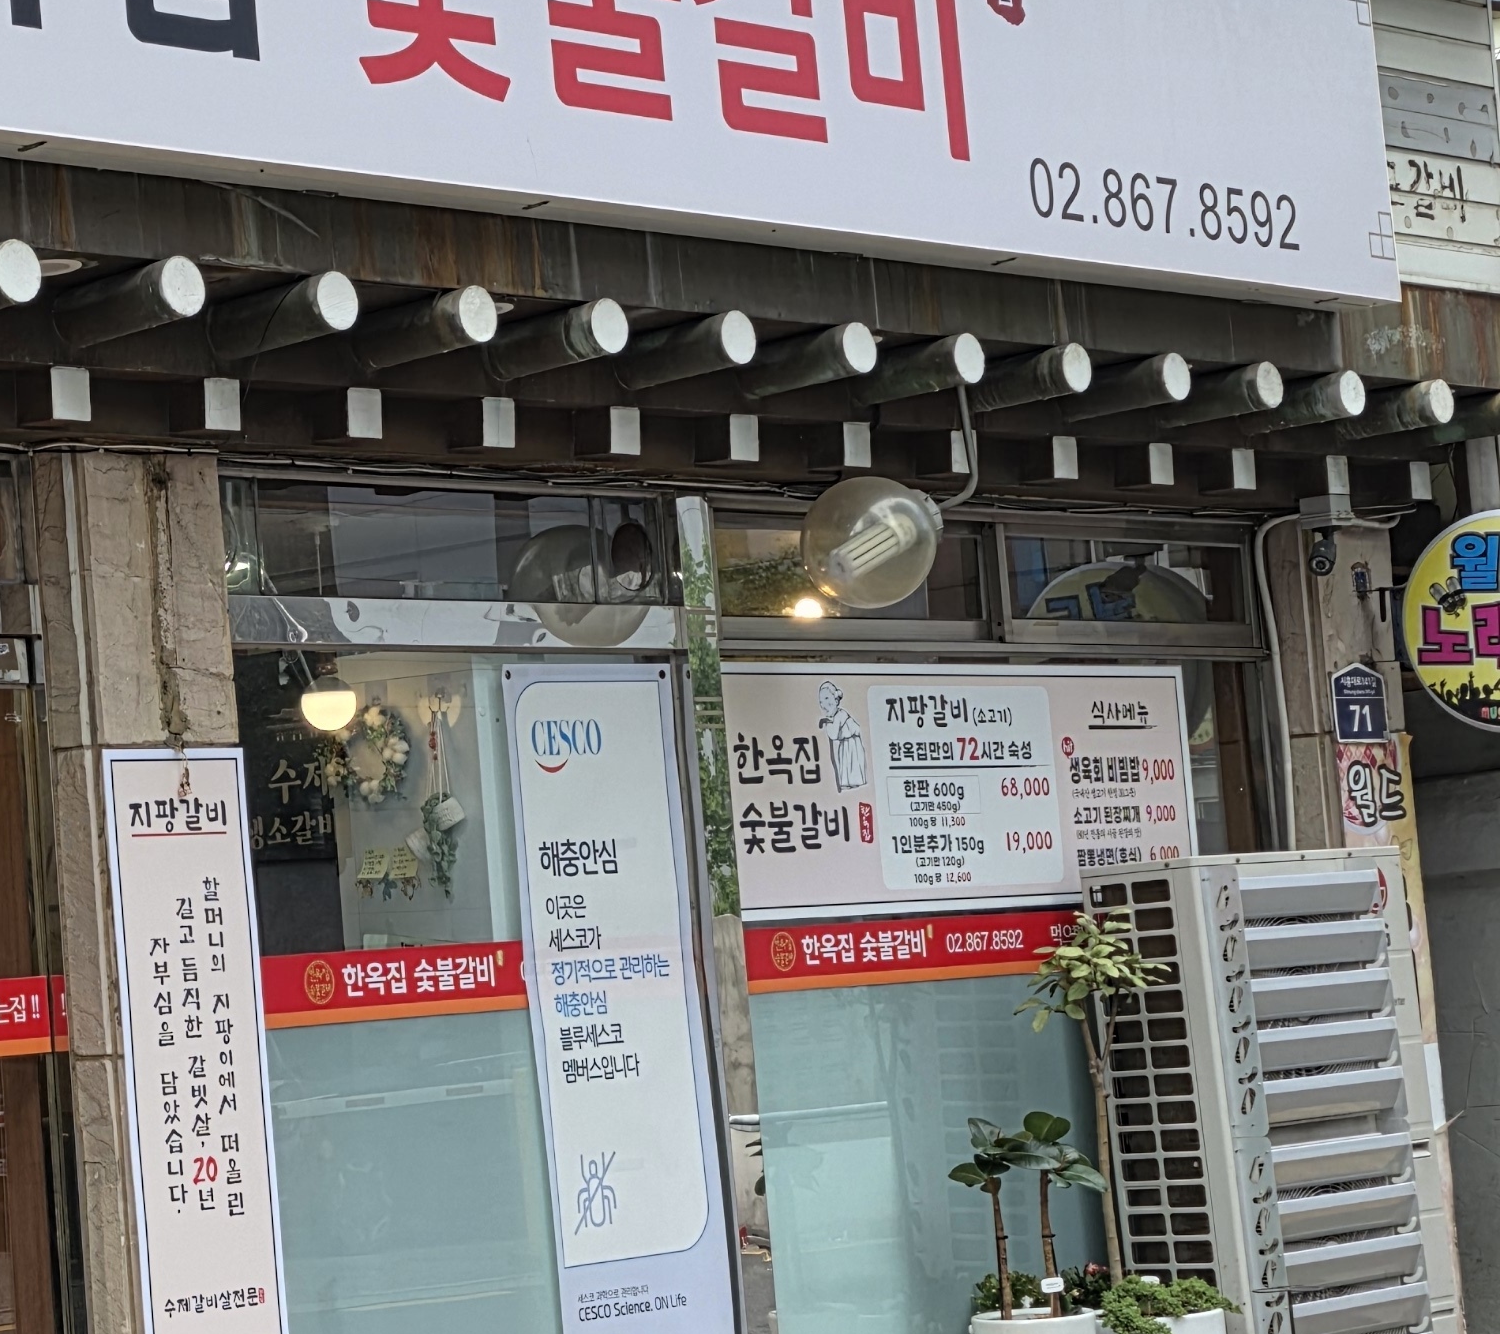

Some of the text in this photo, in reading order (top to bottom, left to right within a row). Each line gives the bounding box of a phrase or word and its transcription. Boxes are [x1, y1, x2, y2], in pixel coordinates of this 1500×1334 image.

[1029, 156, 1301, 252] 02.867.8592
[885, 694, 1013, 728] 지팡갈비 (소고기)
[1091, 700, 1149, 725] 식사메뉴
[1349, 704, 1373, 732] 71
[531, 719, 602, 757] CESCO
[889, 741, 954, 762] 한옥집만의
[1008, 740, 1033, 761] 숙성
[732, 731, 822, 785] 한옥집
[1069, 756, 1105, 784] 생육회
[1142, 758, 1175, 785] 9,000
[903, 779, 965, 800] 한판 600g
[1001, 777, 1051, 800] 68,000
[1347, 760, 1406, 827] 월드
[128, 797, 228, 833] 지팡갈비
[909, 817, 929, 829] 100g
[941, 816, 966, 828] 11,300
[910, 801, 961, 814] (고기만 450g)
[1073, 806, 1102, 824] 소고기
[1145, 804, 1176, 825] 9,000
[739, 800, 850, 855] 숯불갈비
[1006, 831, 1053, 854] 19,000
[538, 839, 619, 878] 해충안심
[892, 834, 985, 854] 1인분추가 150g
[1150, 845, 1180, 861] 6000
[941, 856, 965, 869] 120g)
[914, 873, 934, 885] 100g
[946, 872, 972, 884] 12,600
[175, 897, 195, 944] 길고
[545, 894, 587, 920] 이곳은
[549, 926, 602, 953] 세스코가
[801, 933, 855, 966] 한옥집
[859, 928, 927, 963] 숯불갈비
[946, 929, 1024, 954] 02.867.8592
[341, 960, 407, 997] 한옥집
[413, 954, 496, 993] 숯불갈비
[551, 958, 618, 986] 정기적으로
[619, 954, 670, 981] 관리하는
[180, 957, 204, 1039] 듬직한
[553, 990, 608, 1018] 해충안심
[202, 876, 245, 1217] 할머니의 지팡이에서 떠올린
[559, 1023, 624, 1051] 블루세스코
[149, 937, 189, 1214] 자부심을 담았습니다.
[562, 1053, 640, 1084] 멤버스입니다
[192, 1155, 218, 1211] 20년
[164, 1286, 259, 1318] 수제갈비살전문
[578, 1292, 687, 1322] CESCO Science. ON Life
